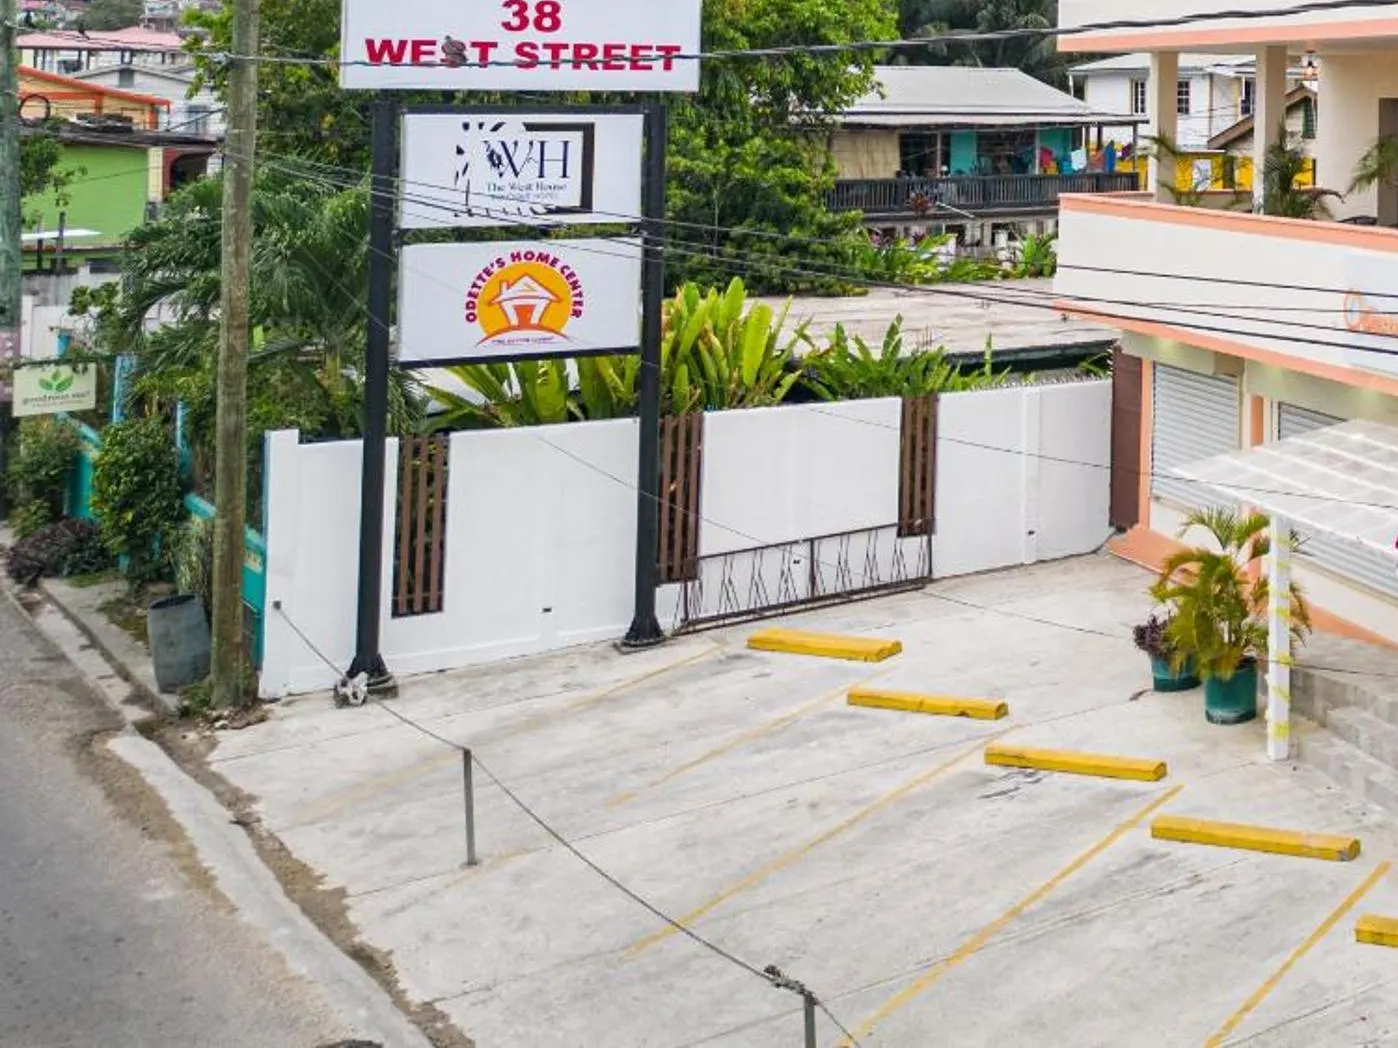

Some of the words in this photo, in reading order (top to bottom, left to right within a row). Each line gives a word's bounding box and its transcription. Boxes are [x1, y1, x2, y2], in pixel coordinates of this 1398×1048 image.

[514, 40, 682, 71] STREET
[487, 181, 505, 192] The
[465, 256, 506, 323] ODETTE'S
[510, 249, 560, 269] HOME
[560, 264, 584, 319] CENTER
